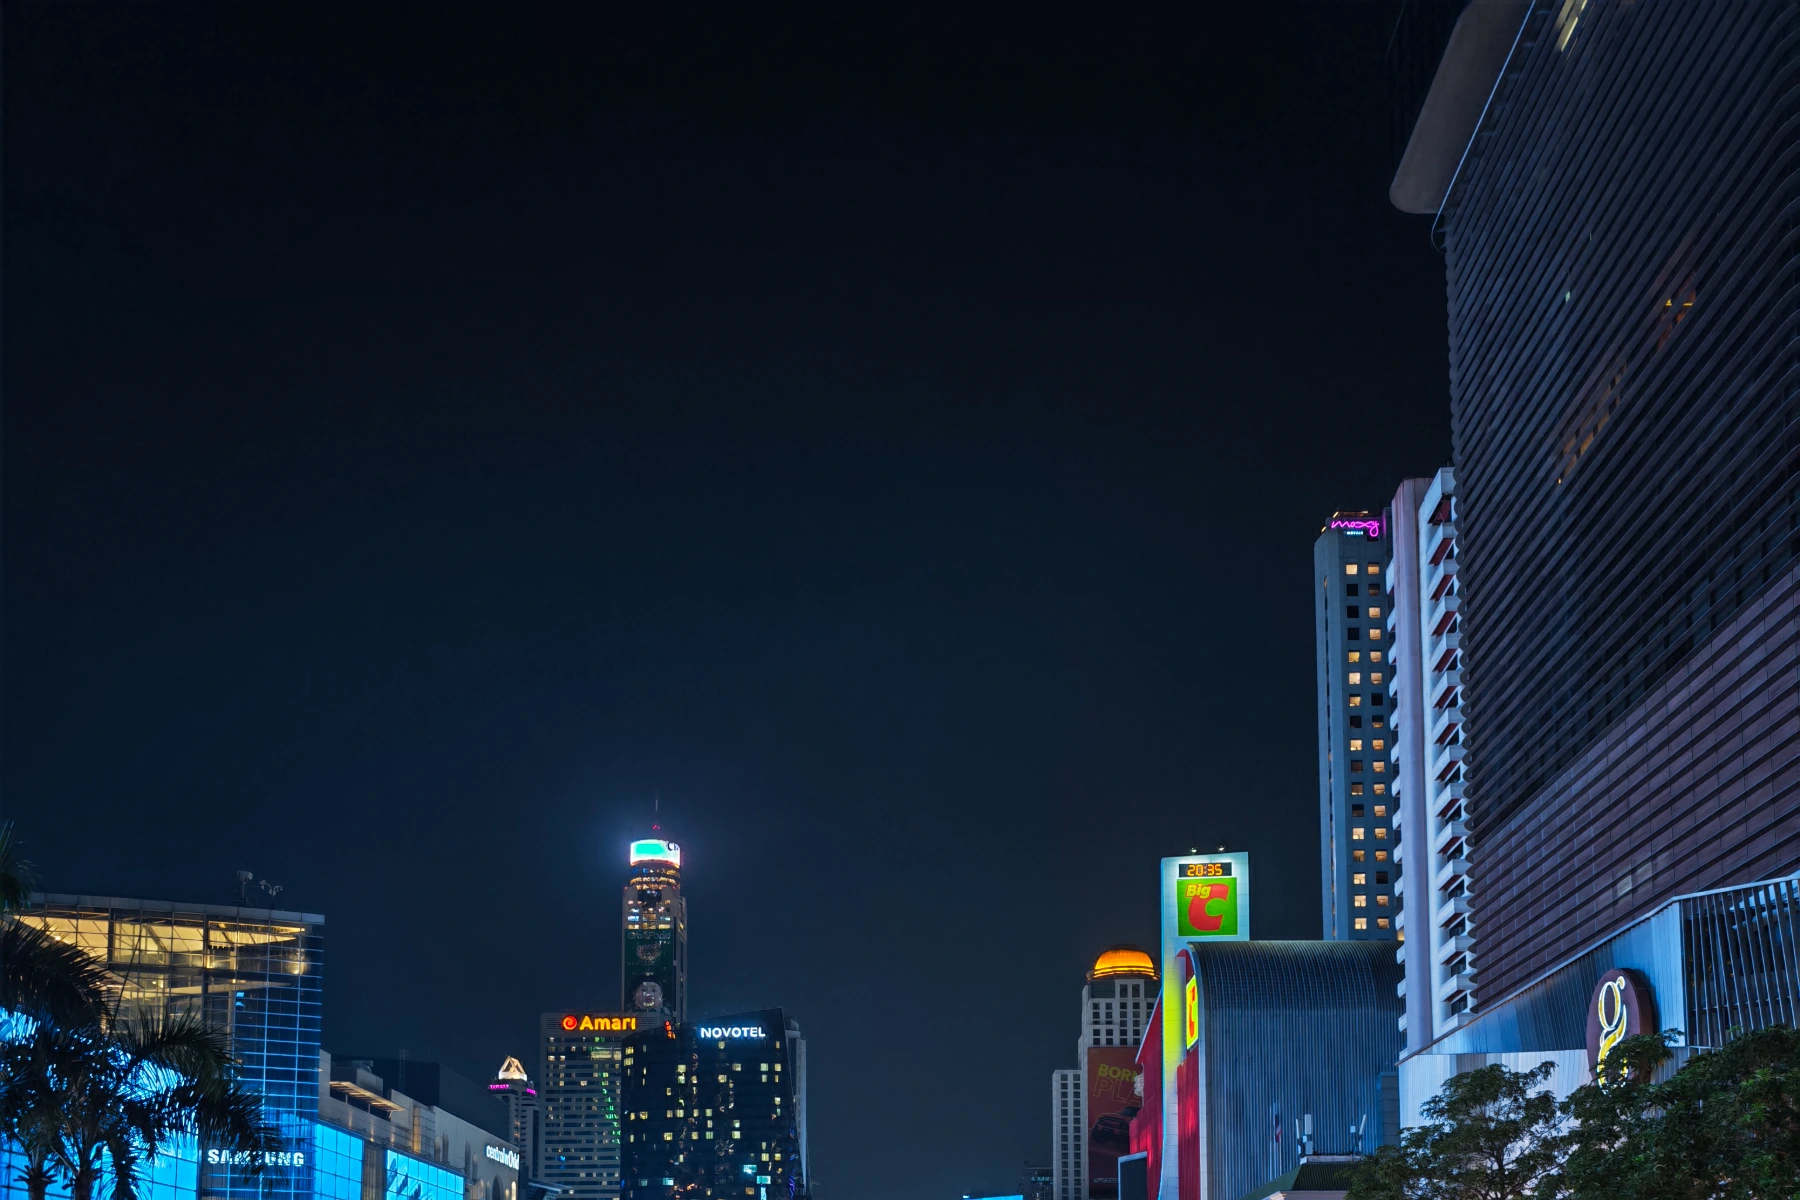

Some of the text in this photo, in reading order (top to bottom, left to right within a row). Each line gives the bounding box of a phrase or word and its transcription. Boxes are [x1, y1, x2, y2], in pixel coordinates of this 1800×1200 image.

[1187, 863, 1223, 876] 20:35
[1185, 882, 1212, 899] Big
[1188, 883, 1229, 932] C
[579, 1015, 636, 1030] Amari
[700, 1026, 765, 1038] NOVOTEL
